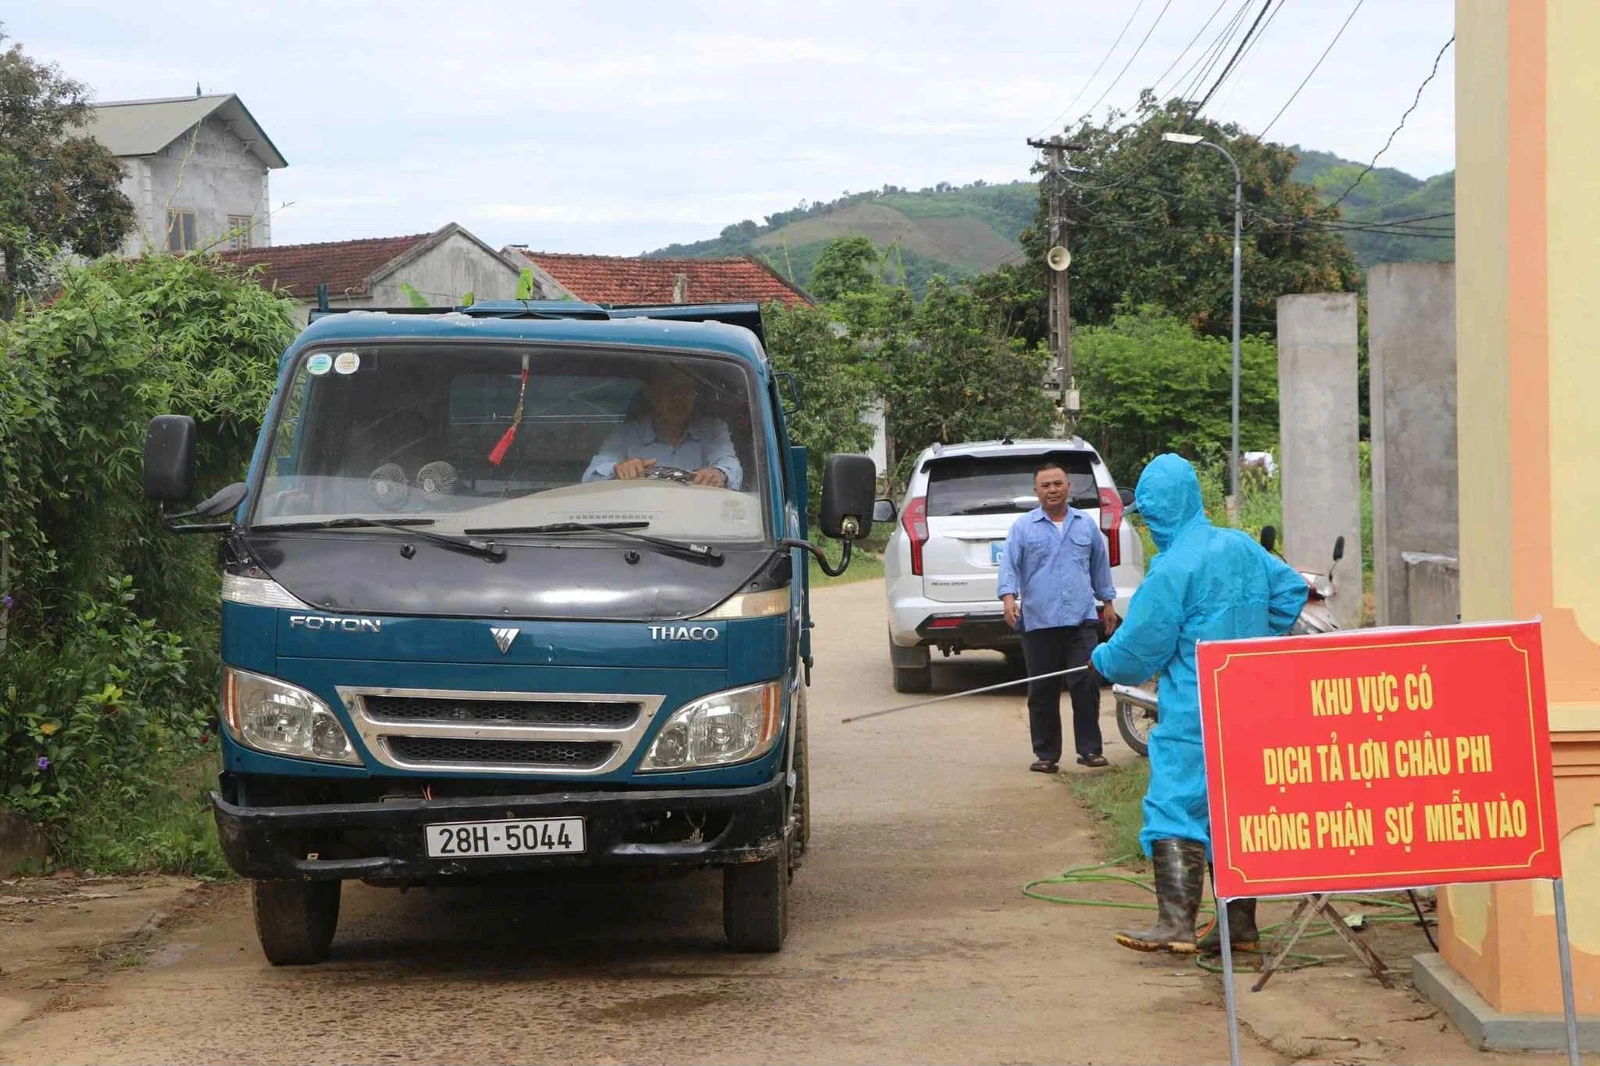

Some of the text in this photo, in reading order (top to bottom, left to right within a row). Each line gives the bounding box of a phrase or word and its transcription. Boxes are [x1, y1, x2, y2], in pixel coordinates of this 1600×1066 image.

[290, 616, 381, 632] FOTON
[648, 626, 719, 641] THACO
[1311, 664, 1434, 722] KHU VỰC CÓ
[1262, 730, 1493, 793] DỊCH TẢ LỢN CHÂU PHI
[438, 823, 572, 854] 28H-5044
[1239, 788, 1528, 856] KHÔNG PHẬN SỰ MIỄN VÀO
